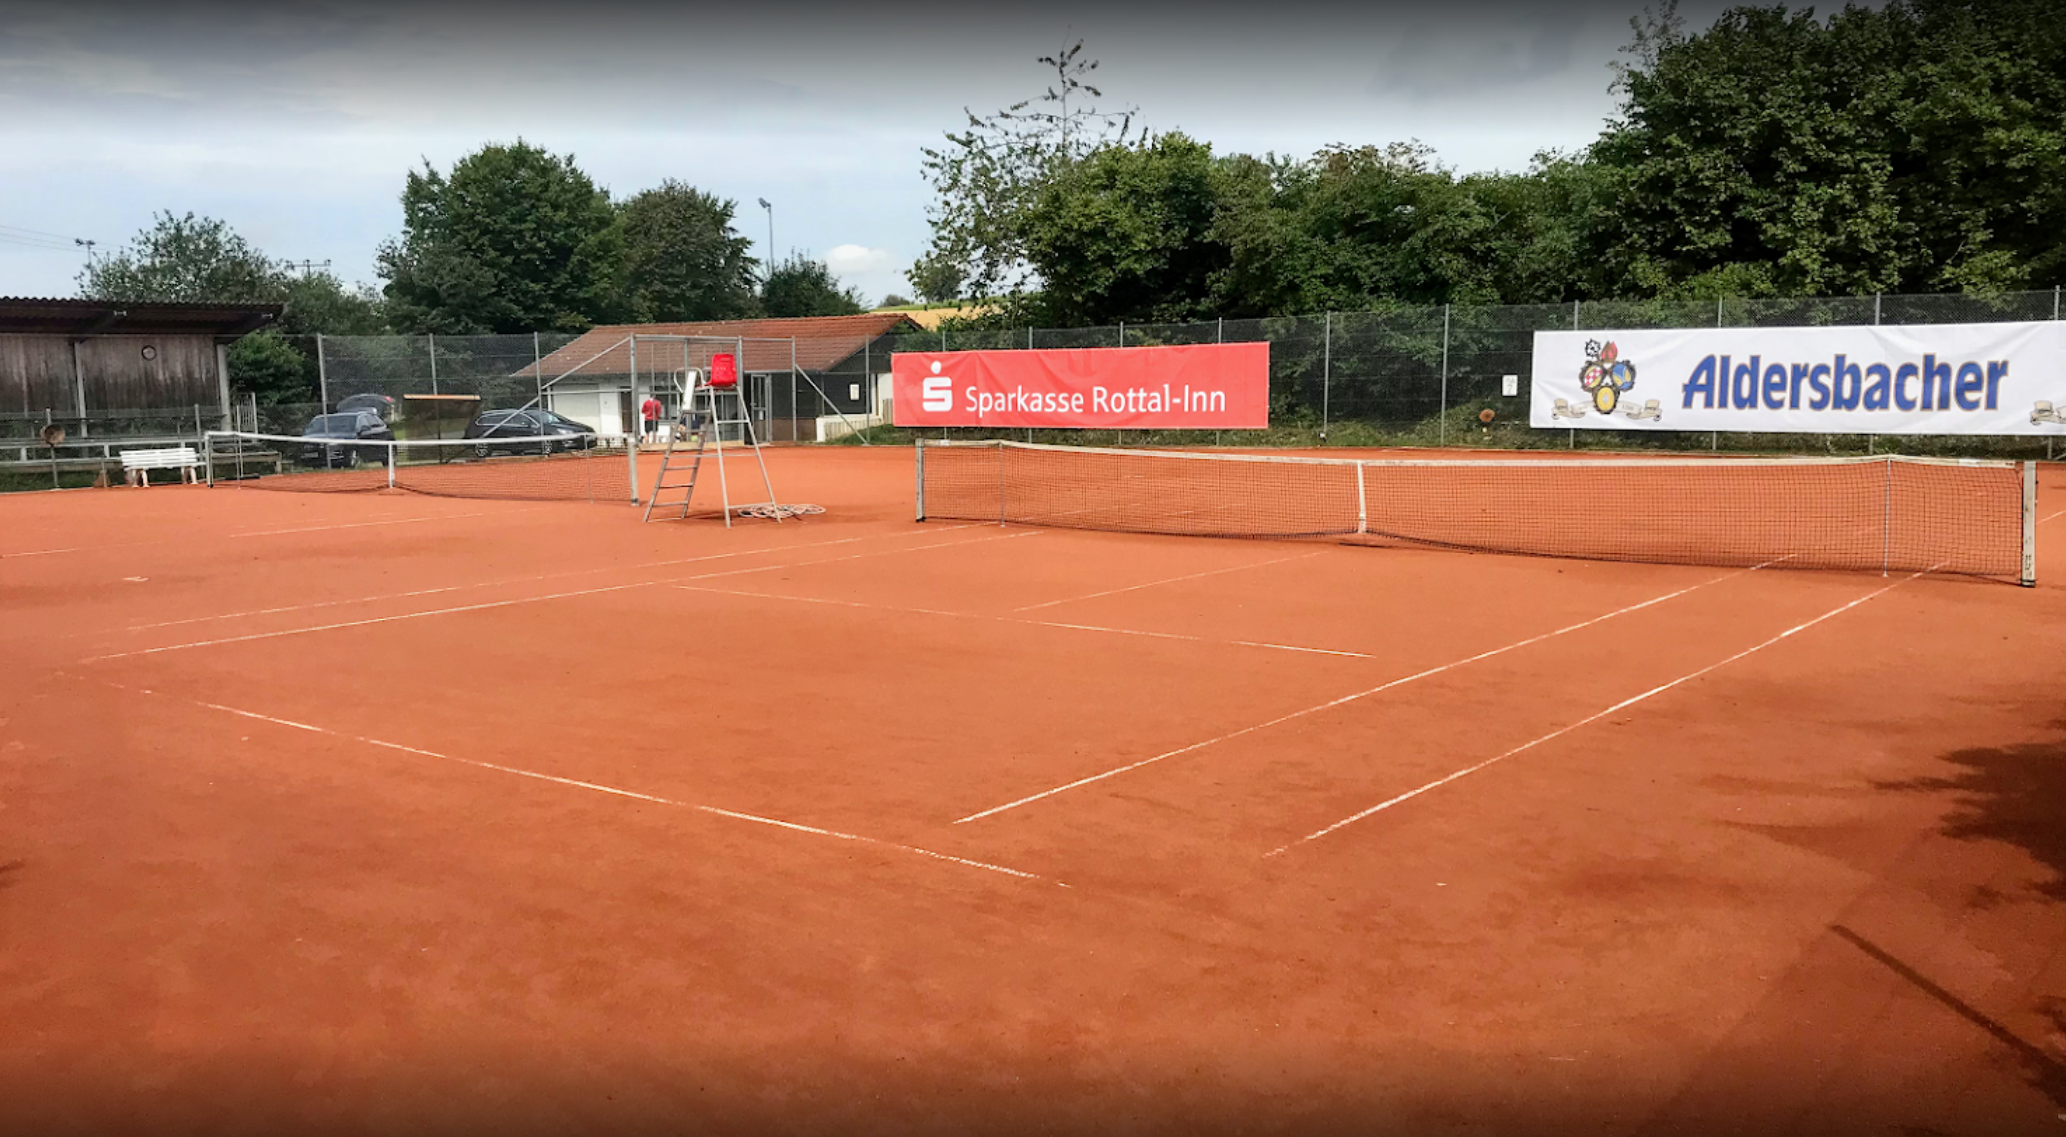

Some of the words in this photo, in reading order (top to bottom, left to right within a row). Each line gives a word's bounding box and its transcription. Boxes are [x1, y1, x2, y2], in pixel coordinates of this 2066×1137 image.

[965, 385, 1084, 418] Sparkasse
[1092, 383, 1226, 413] Rottal-Inn
[1682, 353, 2008, 411] Aldersbacher
